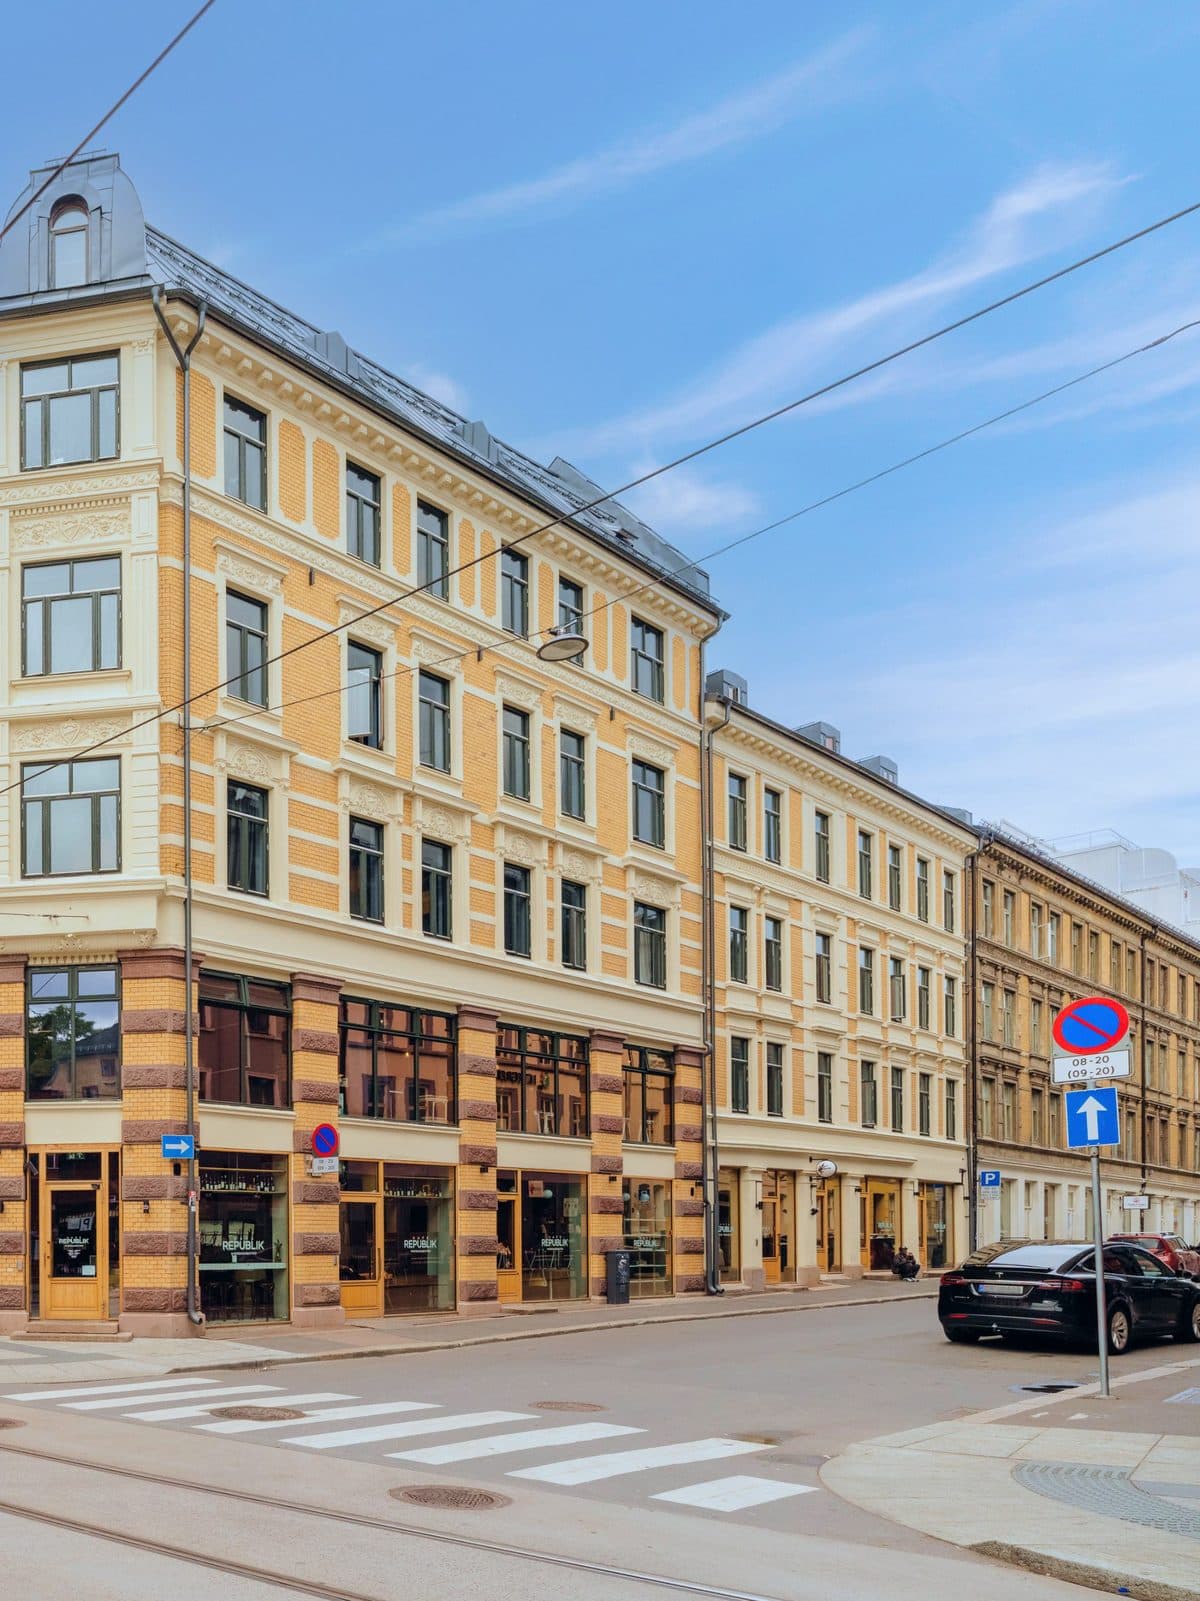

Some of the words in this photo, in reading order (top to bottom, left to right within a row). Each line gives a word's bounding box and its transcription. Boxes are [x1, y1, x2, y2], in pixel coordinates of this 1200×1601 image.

[985, 1173, 996, 1185] P
[222, 1240, 265, 1251] REPUBLIK
[403, 1239, 438, 1249] REPUBLIK
[541, 1238, 569, 1247] REPUBLIK
